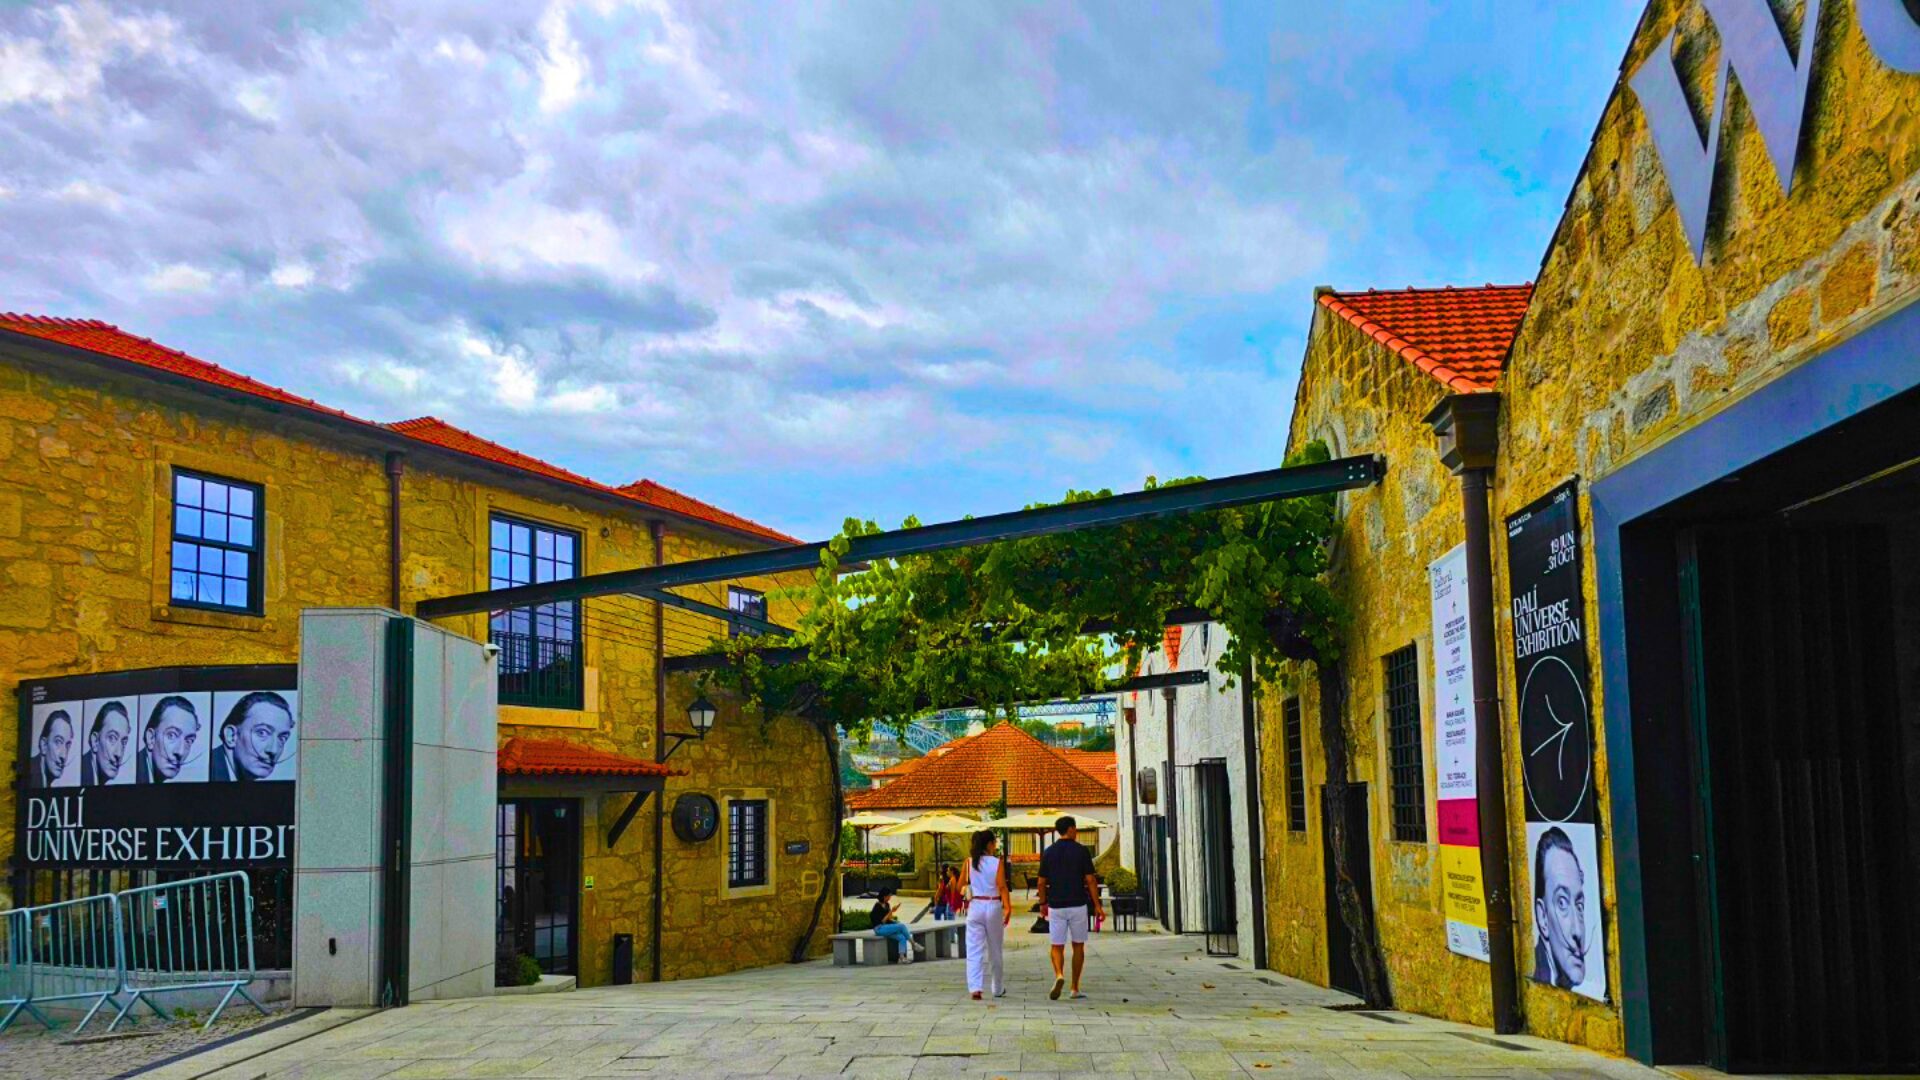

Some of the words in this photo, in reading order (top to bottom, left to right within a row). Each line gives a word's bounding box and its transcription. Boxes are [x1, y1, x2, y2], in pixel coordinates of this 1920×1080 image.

[1549, 537, 1560, 555] 19
[1559, 530, 1575, 553] JUN
[1558, 545, 1576, 567] OCT
[1513, 584, 1538, 618] DALÍ
[1515, 598, 1570, 638] UNIVERSE
[1516, 618, 1580, 659] EXHIBITION
[27, 788, 84, 829] DALÍ
[26, 826, 148, 862] UNIVERSE
